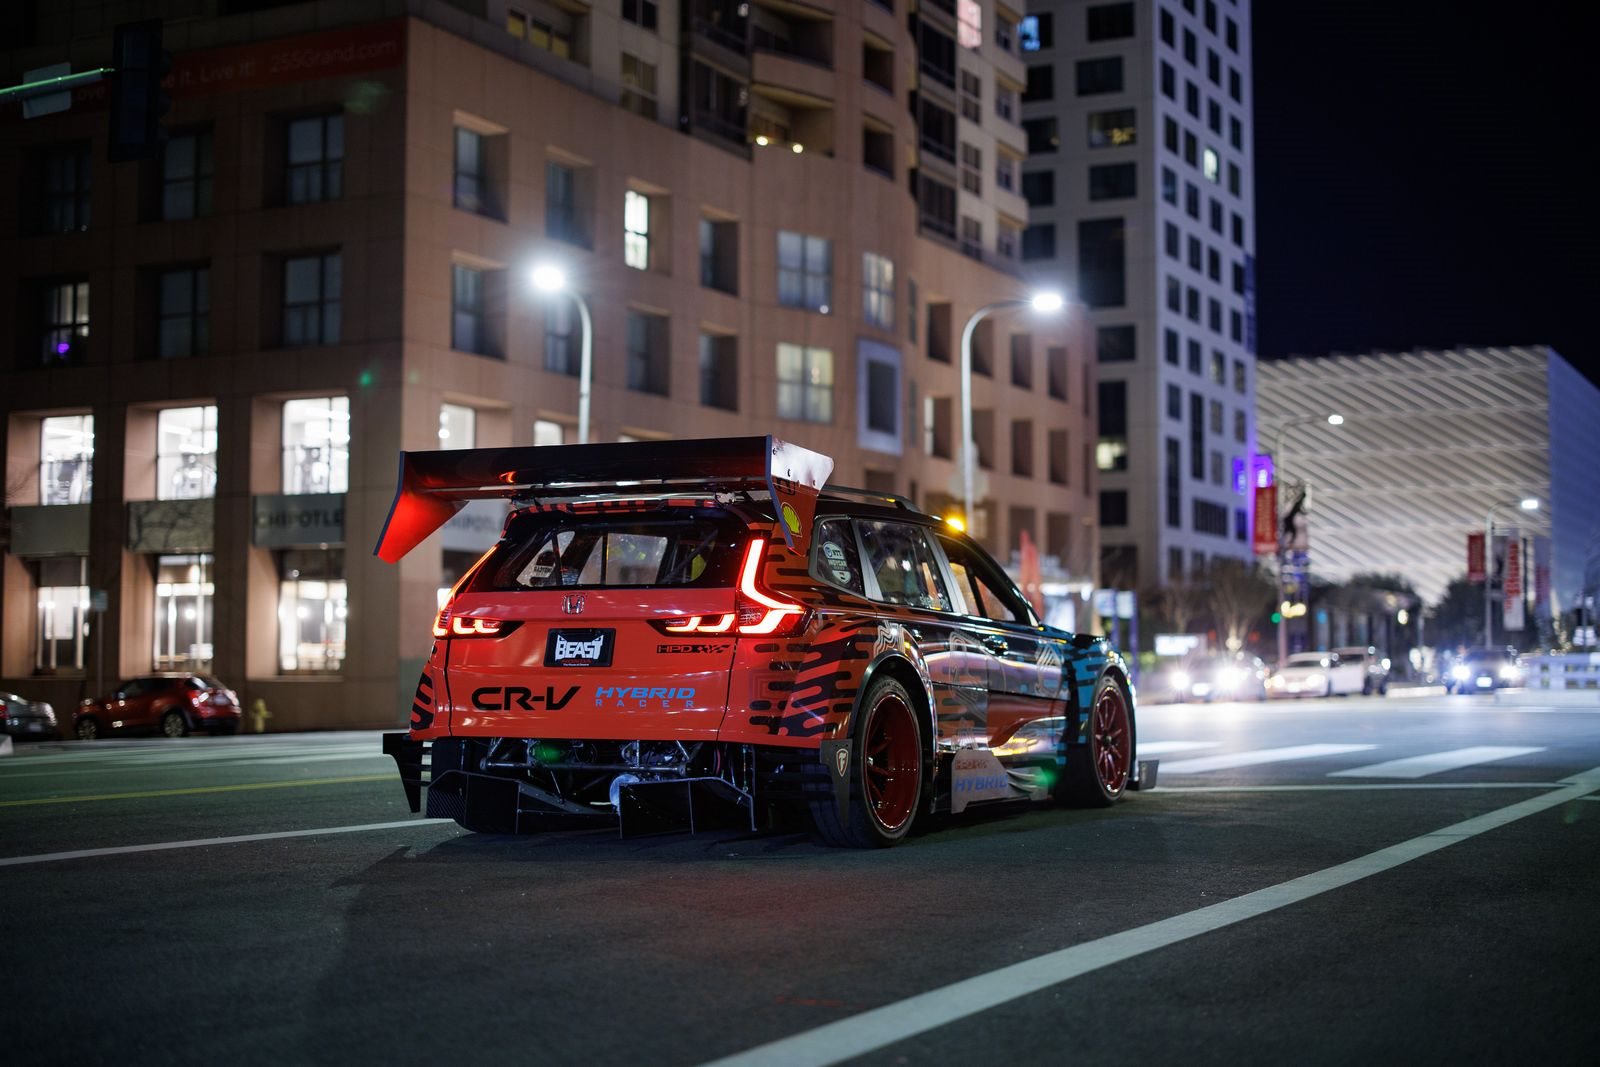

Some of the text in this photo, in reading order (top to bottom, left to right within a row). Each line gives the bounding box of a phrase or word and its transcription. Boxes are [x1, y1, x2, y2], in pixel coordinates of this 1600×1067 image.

[555, 634, 604, 662] BEAST
[657, 645, 693, 653] HPD
[472, 686, 582, 711] CR-V
[595, 687, 696, 699] HYBRID
[595, 700, 694, 708] RACER
[954, 774, 1009, 793] HYBRID
